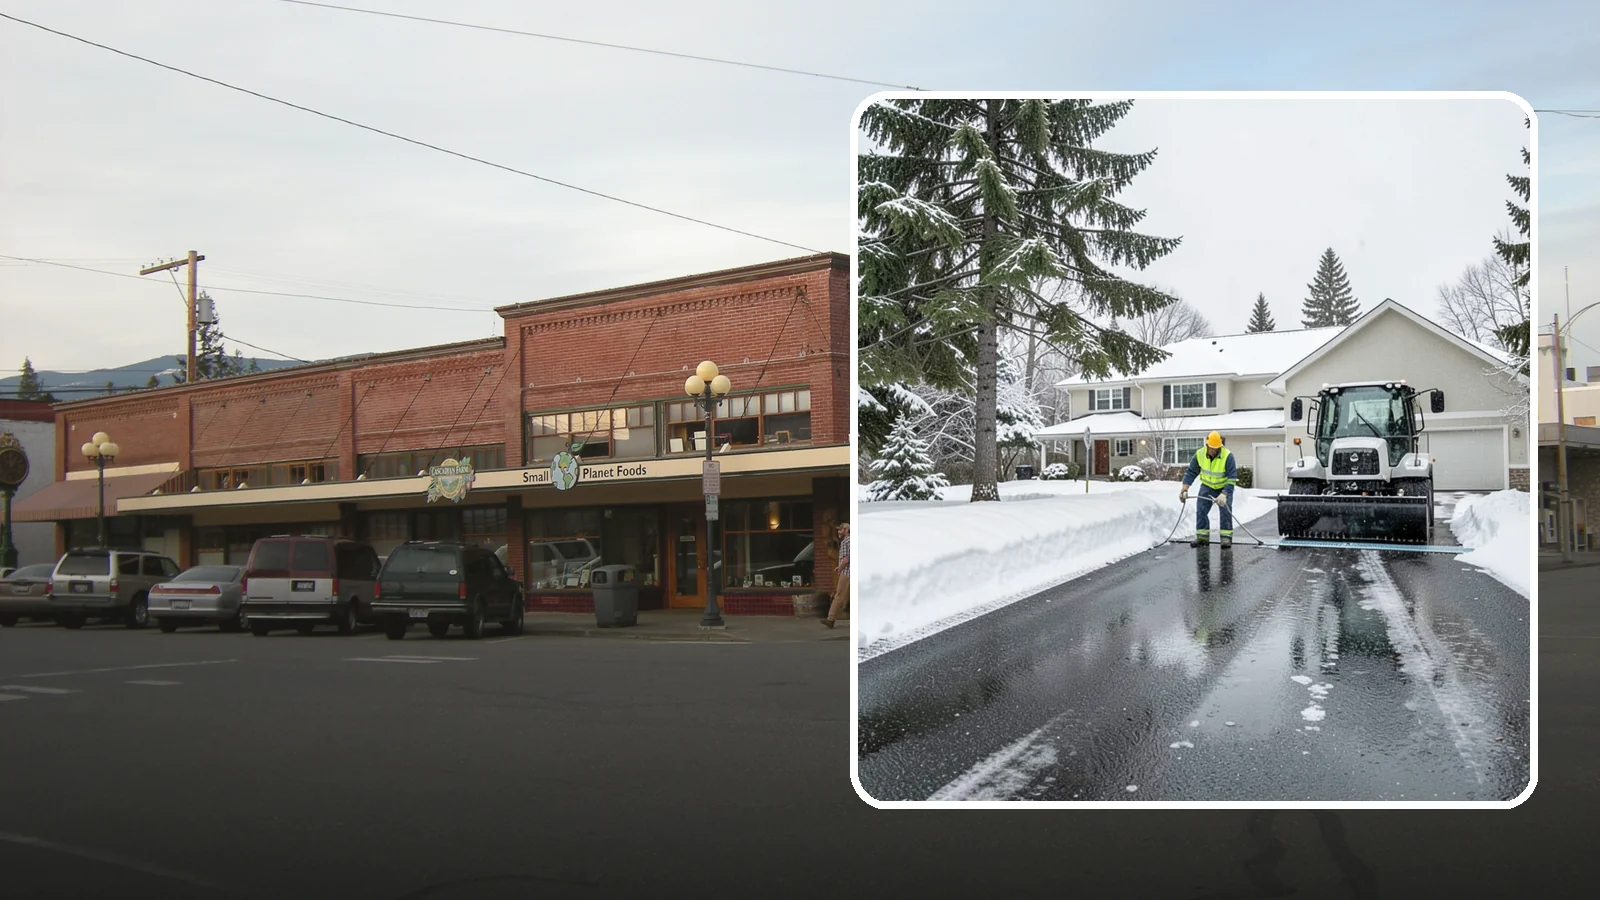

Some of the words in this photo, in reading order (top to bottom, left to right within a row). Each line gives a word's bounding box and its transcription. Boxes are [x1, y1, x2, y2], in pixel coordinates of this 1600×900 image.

[523, 471, 549, 483] Small
[583, 467, 614, 479] Planet
[617, 464, 647, 477] Foods
